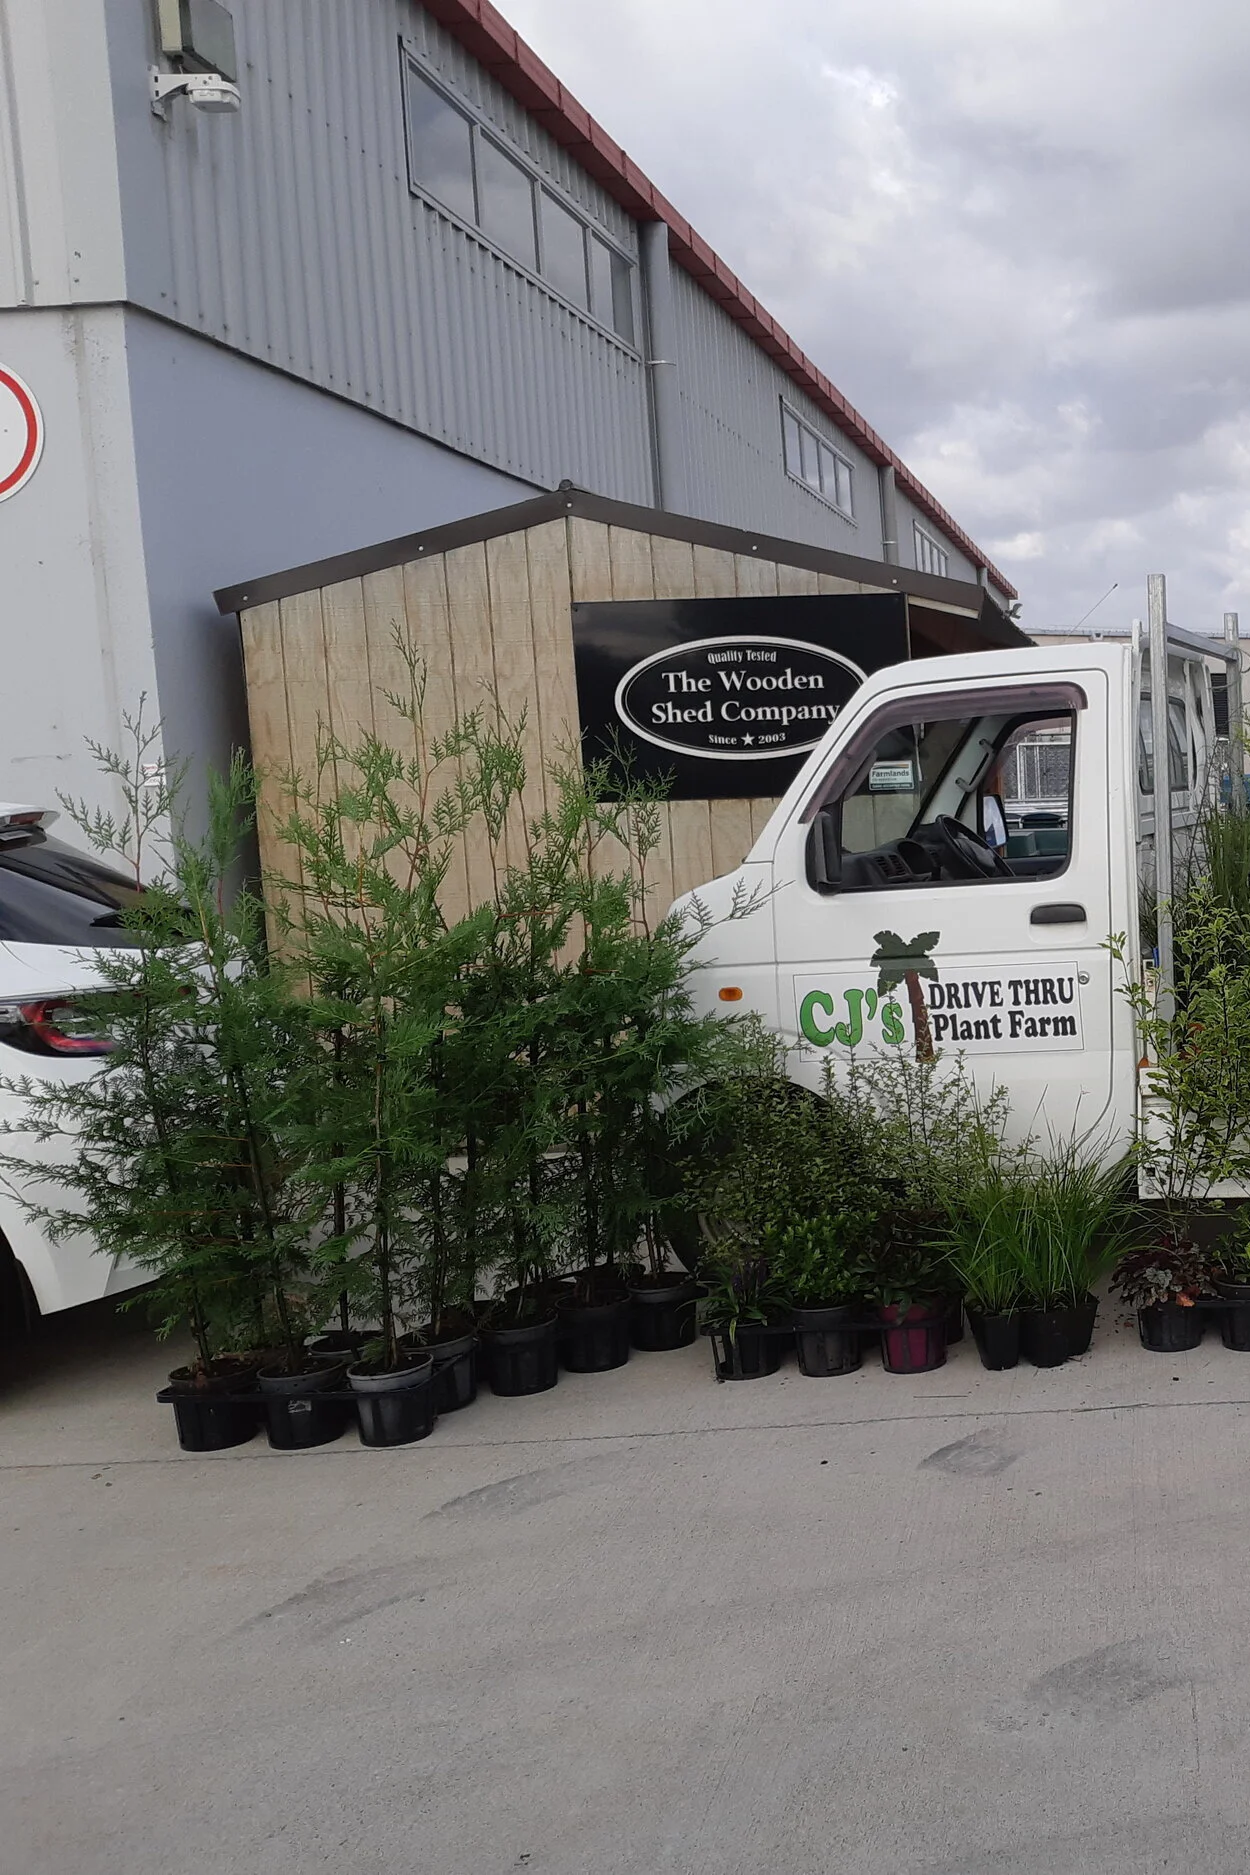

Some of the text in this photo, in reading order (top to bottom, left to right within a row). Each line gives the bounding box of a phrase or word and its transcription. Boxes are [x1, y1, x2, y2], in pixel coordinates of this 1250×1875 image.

[707, 650, 777, 664] Quality Tested
[662, 668, 824, 693] The Wooden
[651, 700, 841, 725] Shed Company
[708, 733, 786, 745] Since 2003
[929, 977, 1075, 1010] DRIVE THRU
[800, 988, 905, 1047] CJ's
[933, 1010, 1077, 1042] Plant Farm
